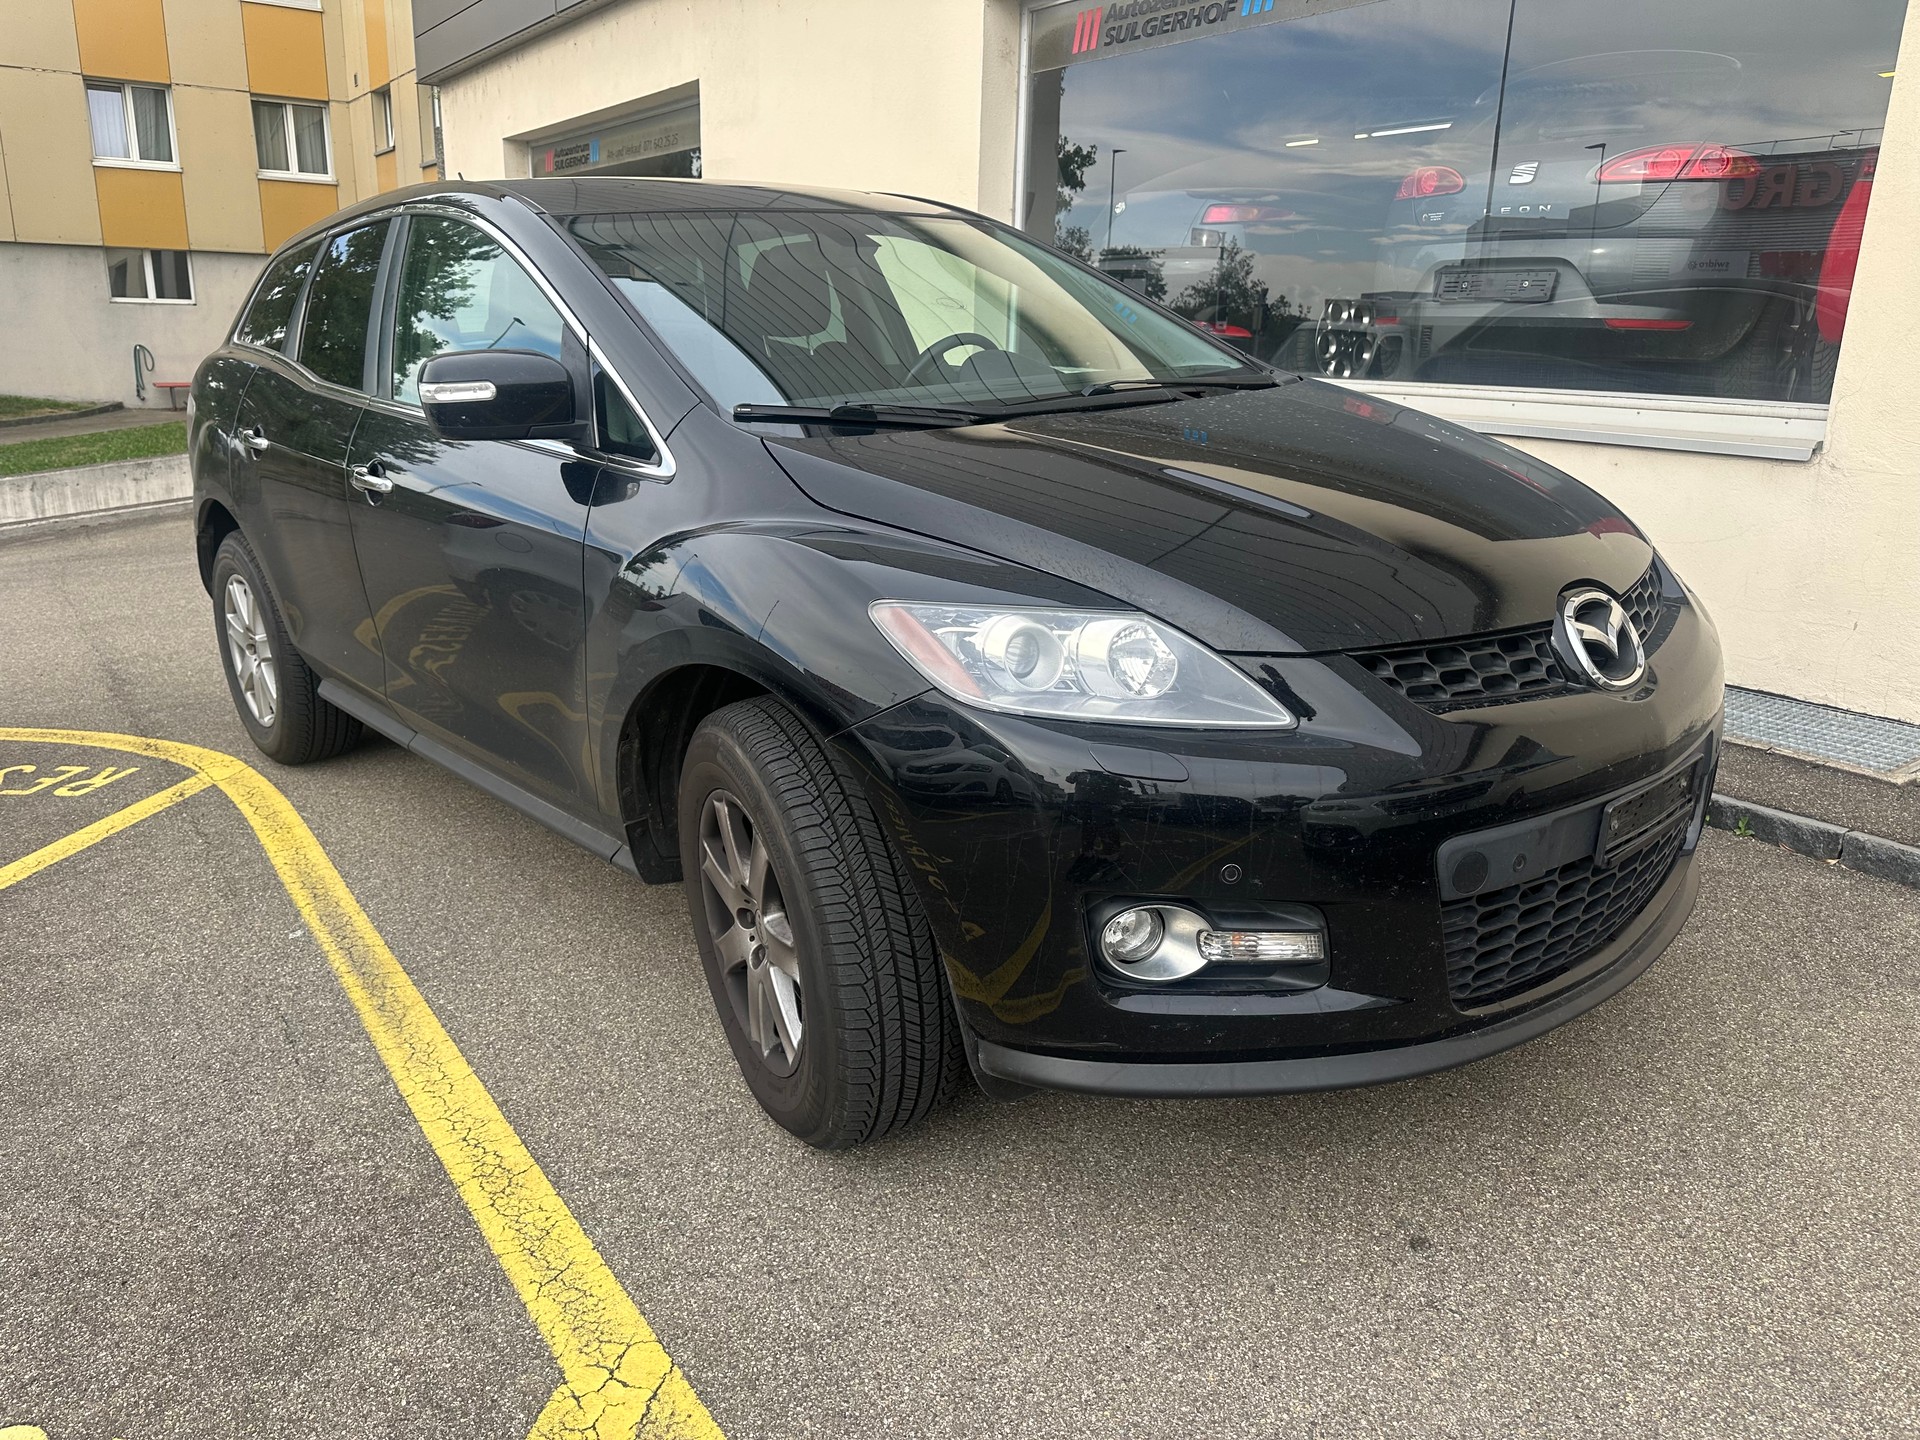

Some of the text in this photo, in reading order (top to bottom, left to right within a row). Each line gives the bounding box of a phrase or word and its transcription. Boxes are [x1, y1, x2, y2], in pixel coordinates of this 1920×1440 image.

[1103, 0, 1238, 47] SULGERHOF
[554, 153, 590, 171] SULGERHOF
[1483, 204, 1552, 216] LEON
